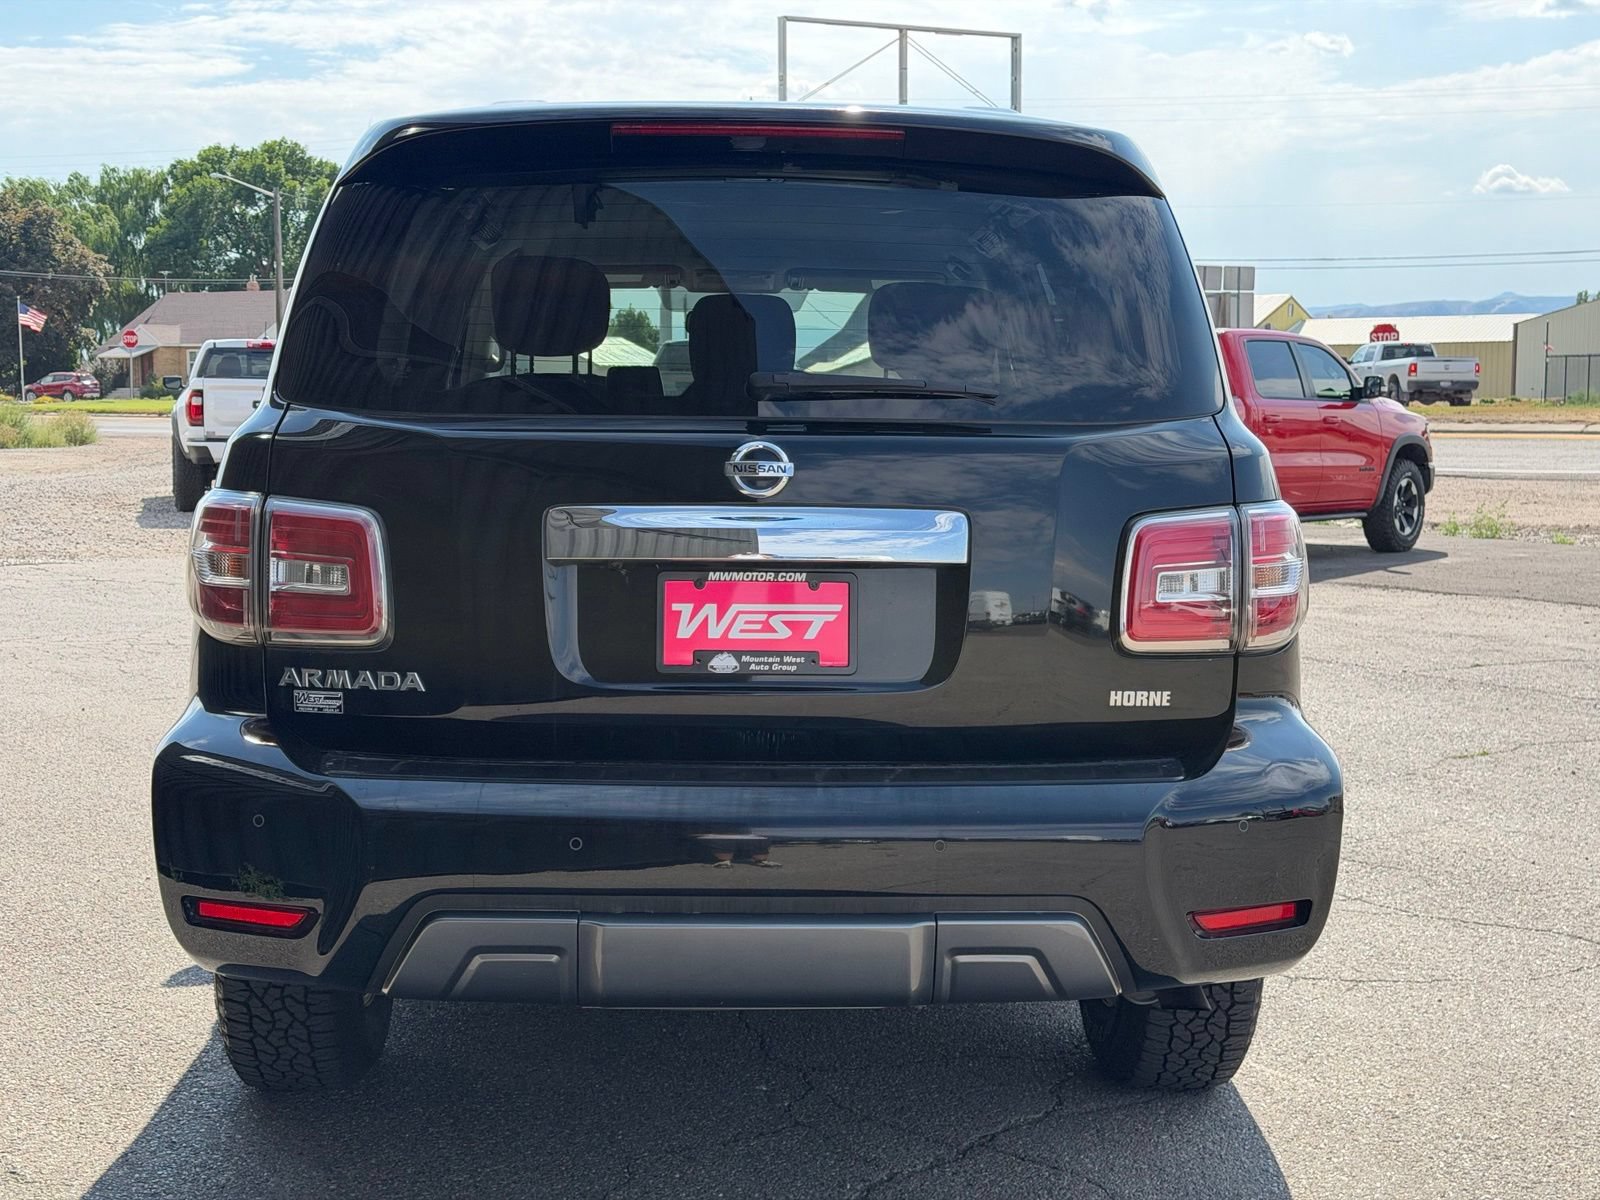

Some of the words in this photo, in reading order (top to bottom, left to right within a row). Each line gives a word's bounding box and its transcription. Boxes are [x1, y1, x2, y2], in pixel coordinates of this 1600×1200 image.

[123, 335, 138, 343] STOP
[1371, 332, 1398, 341] STOP
[733, 464, 787, 473] NISSAN
[708, 571, 807, 582] MWMOTOR.COM
[741, 655, 780, 663] Mountain
[749, 663, 770, 671] Auto
[772, 664, 797, 672] Group
[278, 666, 426, 692] ARMADA
[1109, 690, 1171, 707] HORNE
